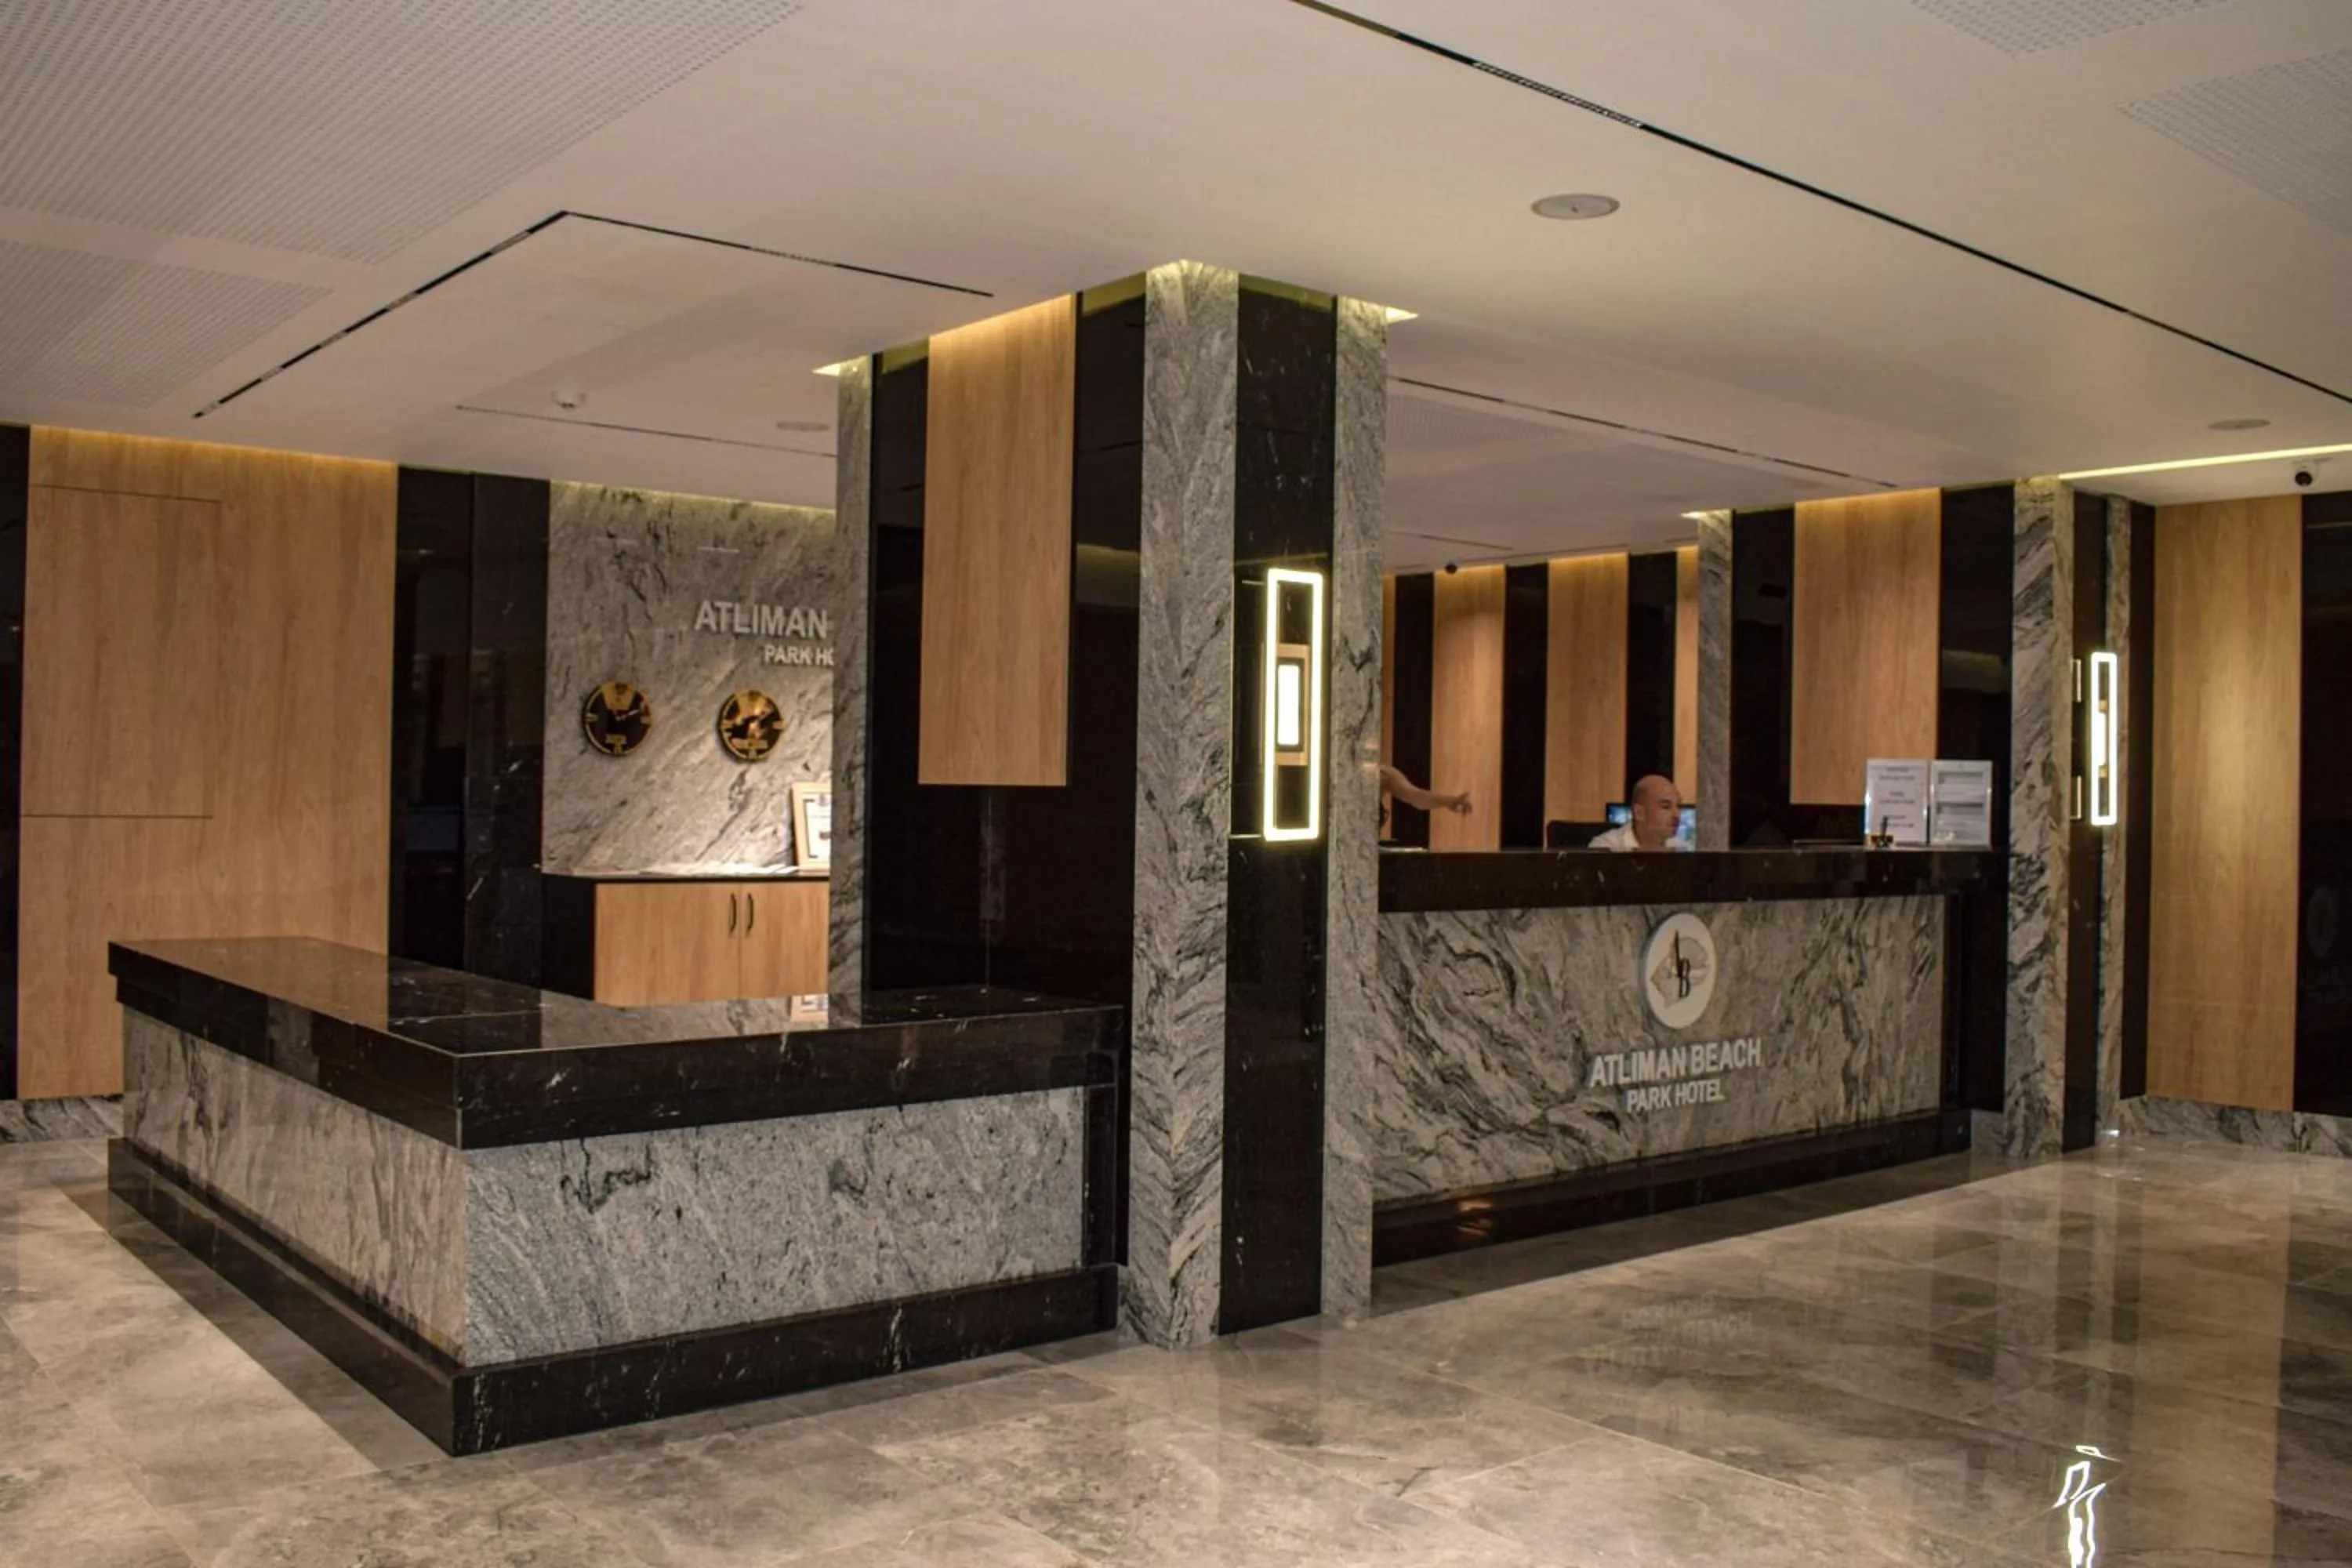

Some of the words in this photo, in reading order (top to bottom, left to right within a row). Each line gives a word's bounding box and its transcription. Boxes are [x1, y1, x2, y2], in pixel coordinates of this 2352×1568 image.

[694, 600, 828, 638] ATLIMAN
[764, 644, 812, 666] PARK
[1589, 1045, 1686, 1088] ATLIMAN
[1690, 1037, 1761, 1075] BEACH
[1627, 1084, 1671, 1112] PARK
[1675, 1077, 1726, 1106] HOTEL
